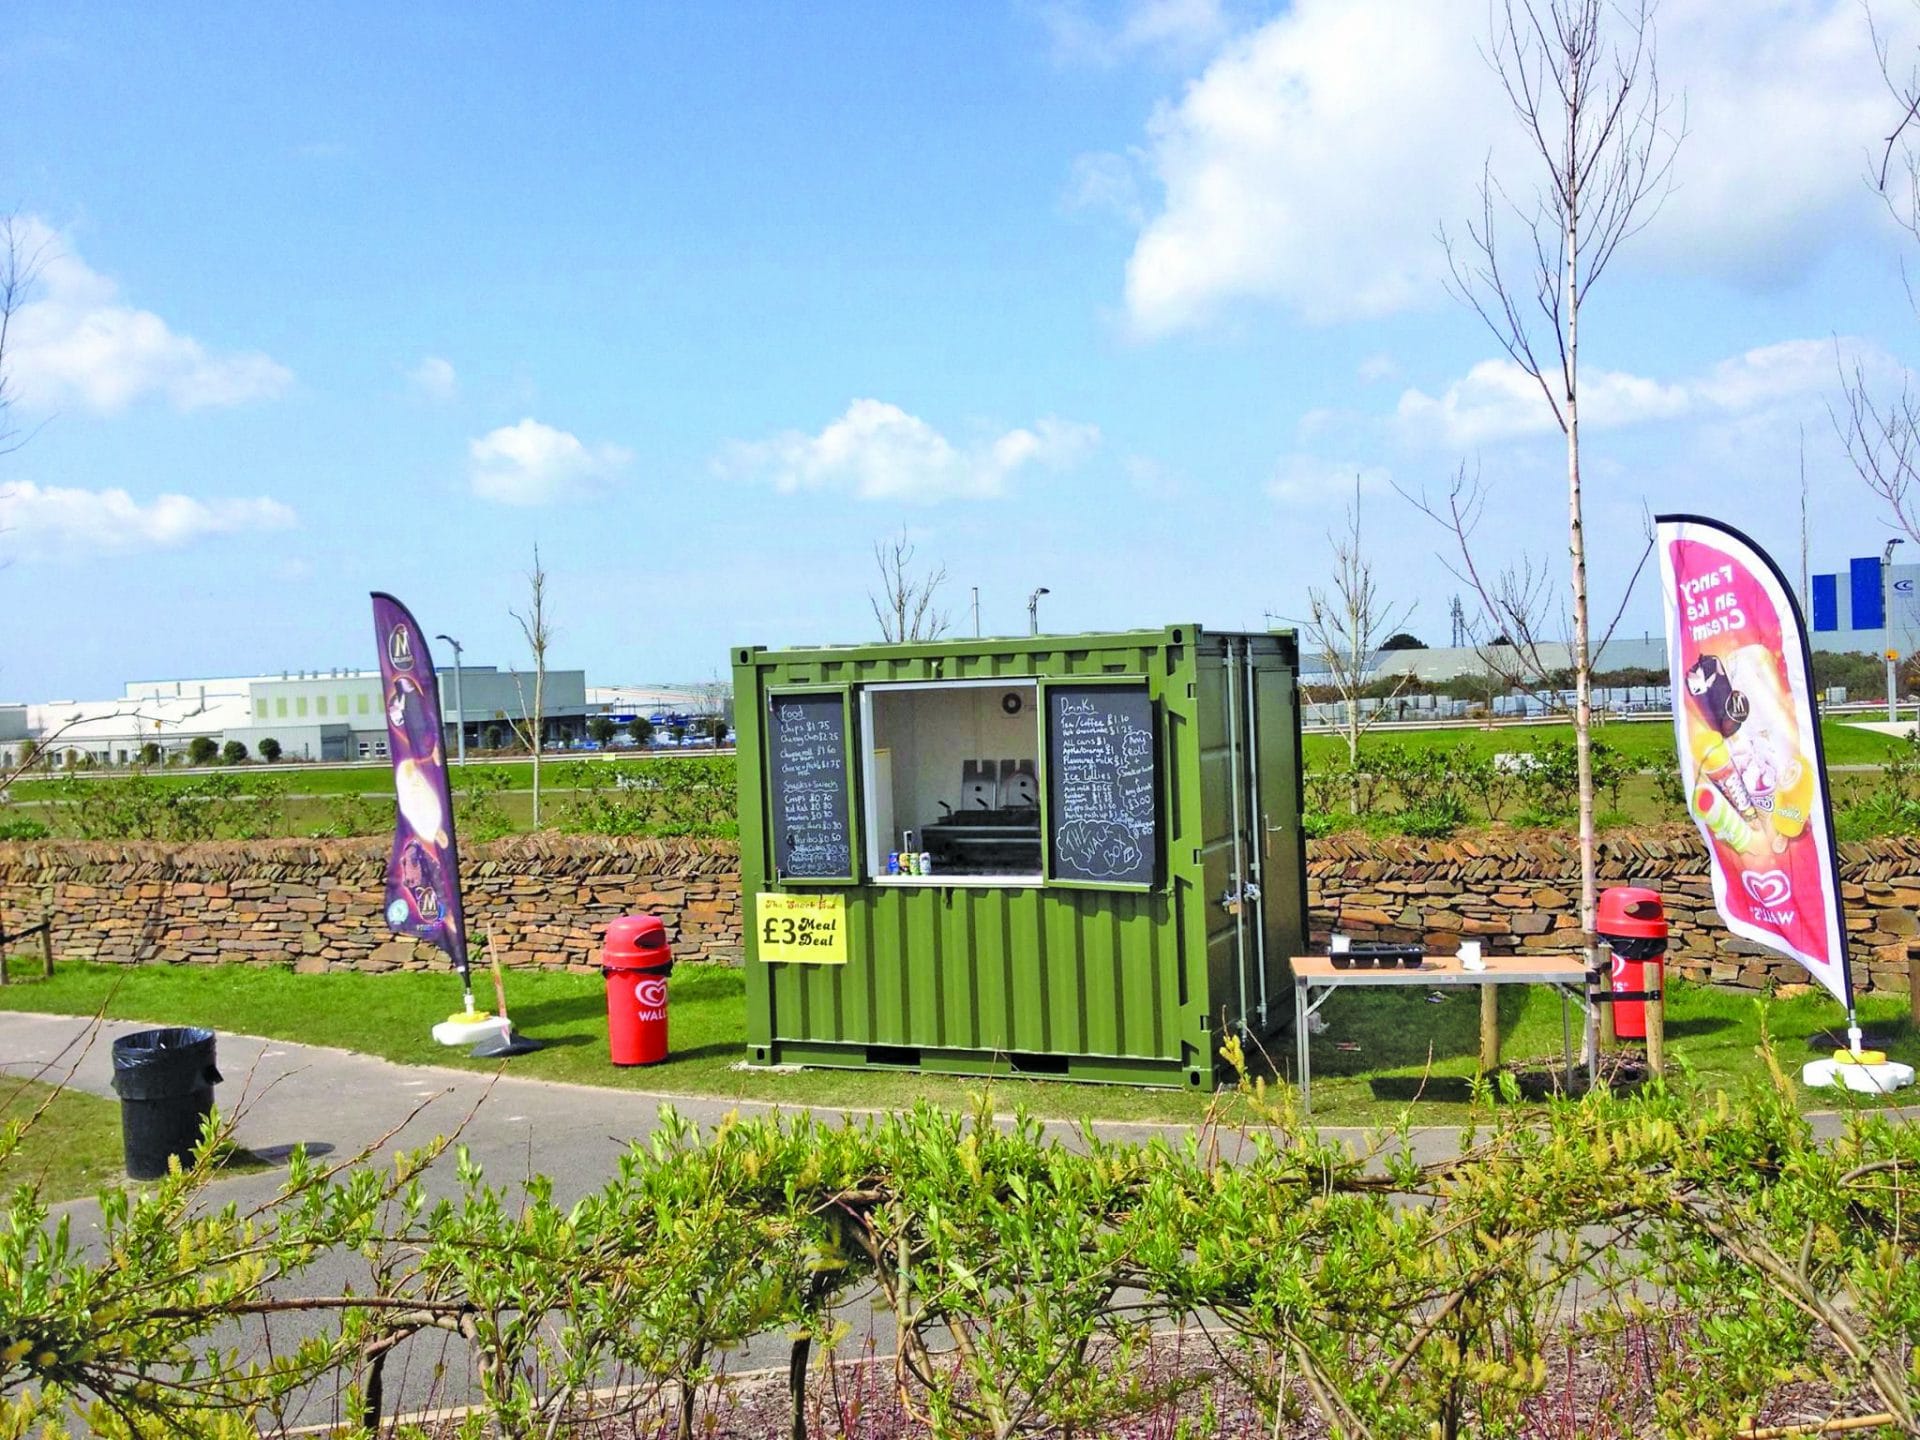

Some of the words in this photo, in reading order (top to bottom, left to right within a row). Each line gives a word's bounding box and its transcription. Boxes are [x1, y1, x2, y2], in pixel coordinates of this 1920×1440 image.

[781, 704, 804, 719] Food
[1065, 822, 1092, 851] THE
[763, 917, 797, 945] £3
[798, 917, 836, 931] Meal
[798, 932, 833, 946] Deal
